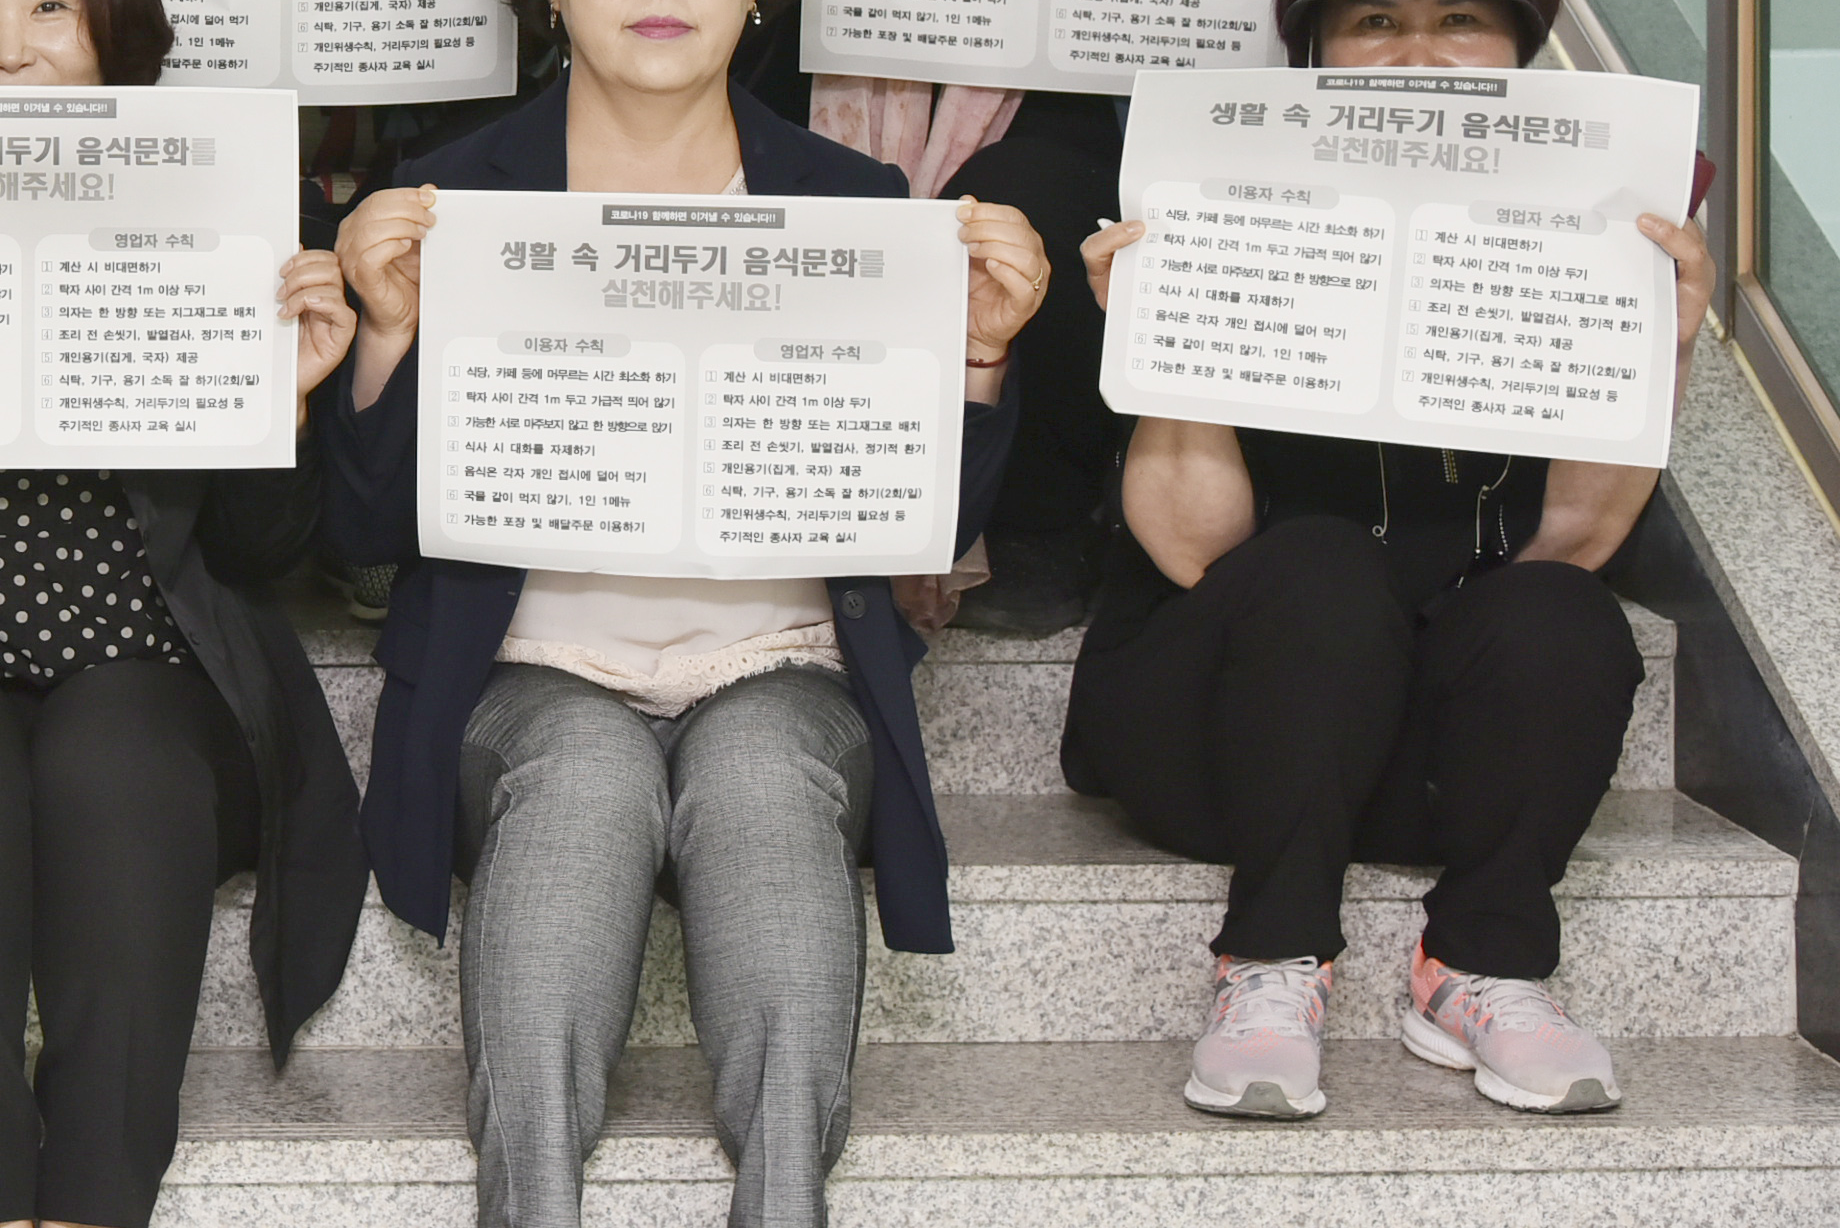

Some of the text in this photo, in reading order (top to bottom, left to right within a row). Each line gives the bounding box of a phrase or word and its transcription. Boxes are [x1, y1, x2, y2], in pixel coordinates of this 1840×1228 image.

[314, 60, 434, 73] 주기적인 종사자 교육 실시
[24, 103, 50, 112] 이겨낼
[53, 103, 63, 113] 수
[67, 103, 107, 113] 있습니다!!
[1210, 103, 1610, 151] 생활 속 거리두기 음식문화를
[75, 137, 216, 166] 음식문화를
[1312, 134, 1500, 174] 실천해주세요!
[1228, 185, 1311, 205] 이용자 수칙
[611, 210, 775, 223] 코로나19 함께하면 이겨낼 수 있습니다!!
[1497, 208, 1580, 230] 영업자 수칙
[115, 233, 193, 248] 영업자 수칙
[501, 242, 884, 278] 생활 속 거리두기 음식문화를
[601, 279, 781, 311] 실천해주세요!
[525, 338, 603, 353] 이용자 수칙
[781, 344, 860, 360] 영업자 수칙
[1419, 396, 1564, 420] 주기적인 종사자 교육 실시
[59, 421, 195, 432] 주기적인 종사자 교육 실시
[720, 531, 856, 543] 주기적인 종사자 교육 실시
